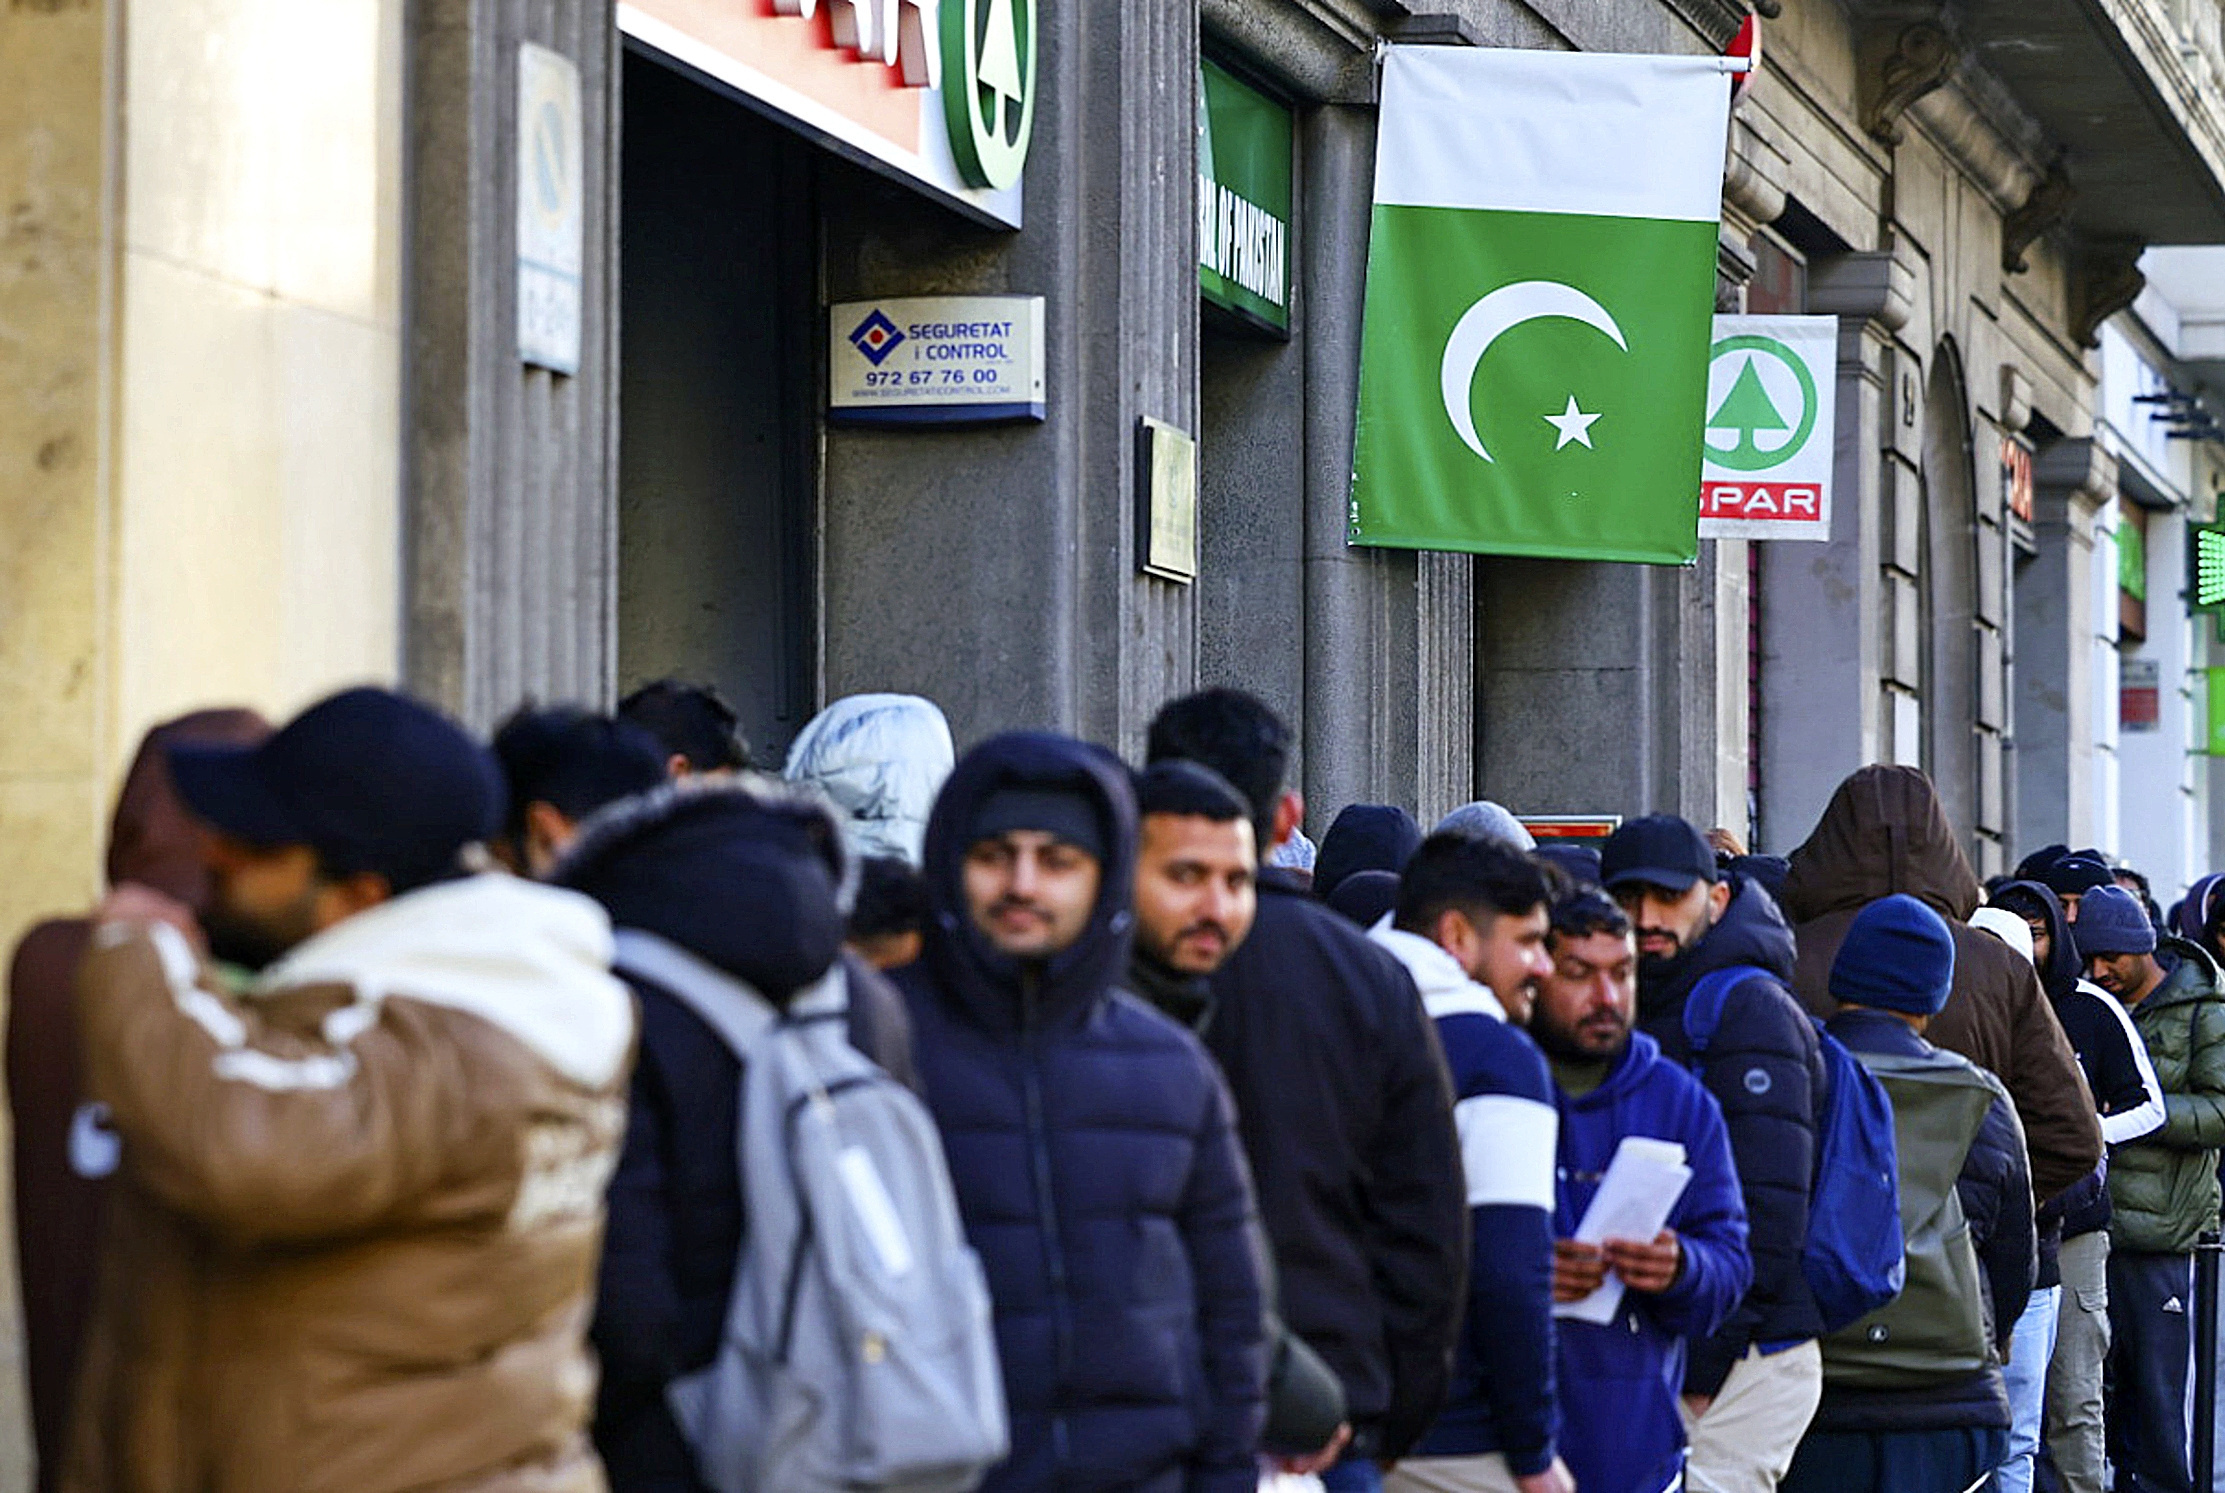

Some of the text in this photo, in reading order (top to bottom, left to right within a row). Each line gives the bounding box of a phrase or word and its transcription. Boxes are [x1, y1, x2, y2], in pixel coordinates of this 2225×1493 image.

[1218, 184, 1235, 279] OF
[1233, 194, 1285, 308] PAKISTAN
[909, 322, 1013, 340] SEGURETAT
[926, 343, 1008, 360] CONTROL
[866, 368, 997, 387] 972 67 76 00
[1700, 486, 1815, 514] PAR
